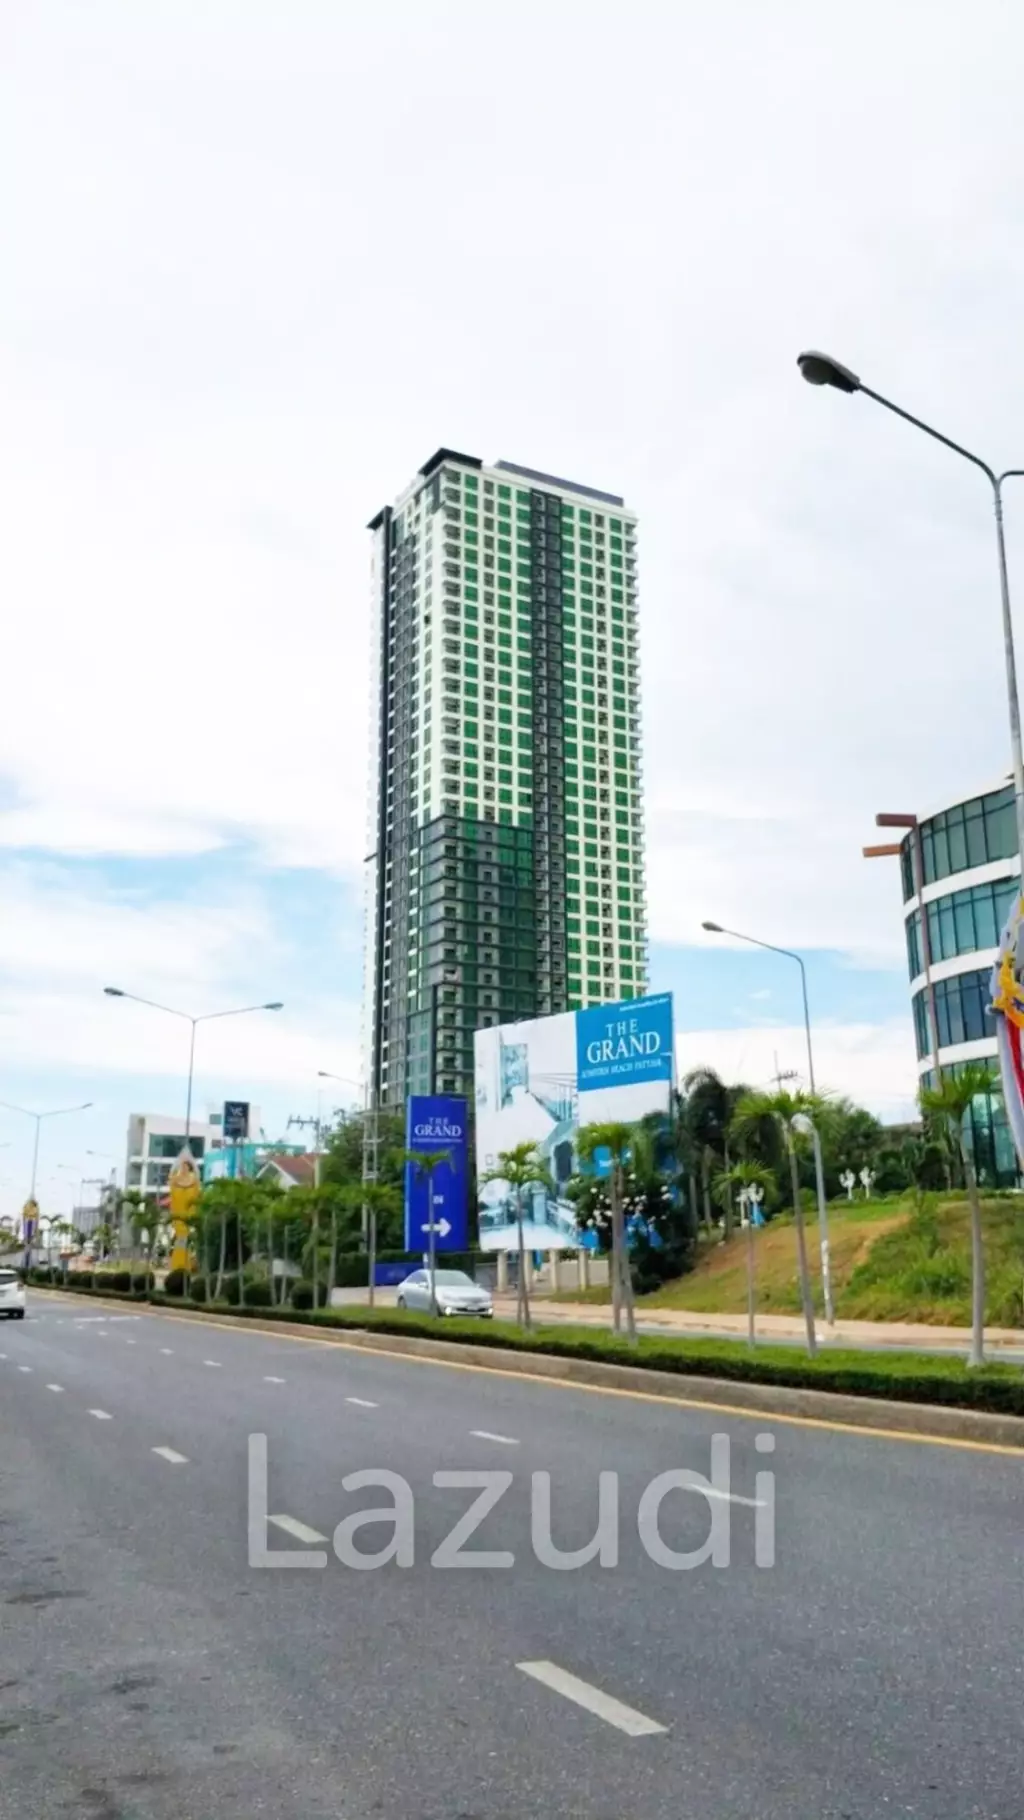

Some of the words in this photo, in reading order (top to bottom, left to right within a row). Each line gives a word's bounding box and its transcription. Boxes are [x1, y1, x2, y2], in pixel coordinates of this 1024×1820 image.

[605, 1019, 638, 1038] THE
[587, 1031, 661, 1064] GRAND
[414, 1124, 462, 1137] GRAND
